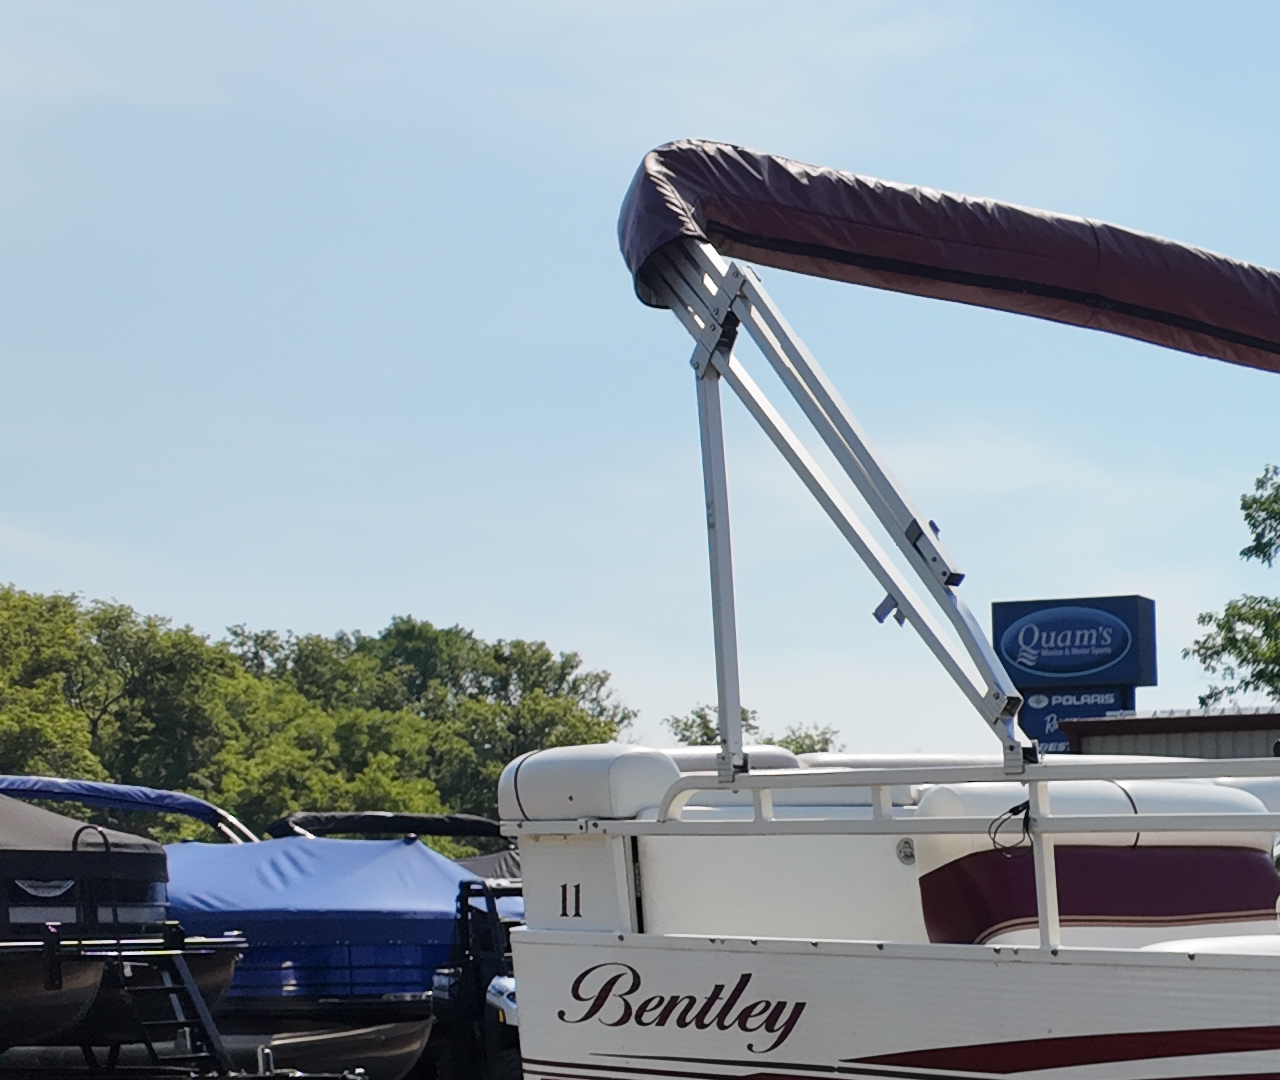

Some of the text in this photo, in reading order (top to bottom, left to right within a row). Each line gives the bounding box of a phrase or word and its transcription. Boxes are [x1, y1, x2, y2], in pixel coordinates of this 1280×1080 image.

[1018, 623, 1113, 652] Quam's
[1051, 693, 1115, 707] POLARIS
[559, 883, 583, 918] 11
[557, 962, 807, 1054] Bentley
